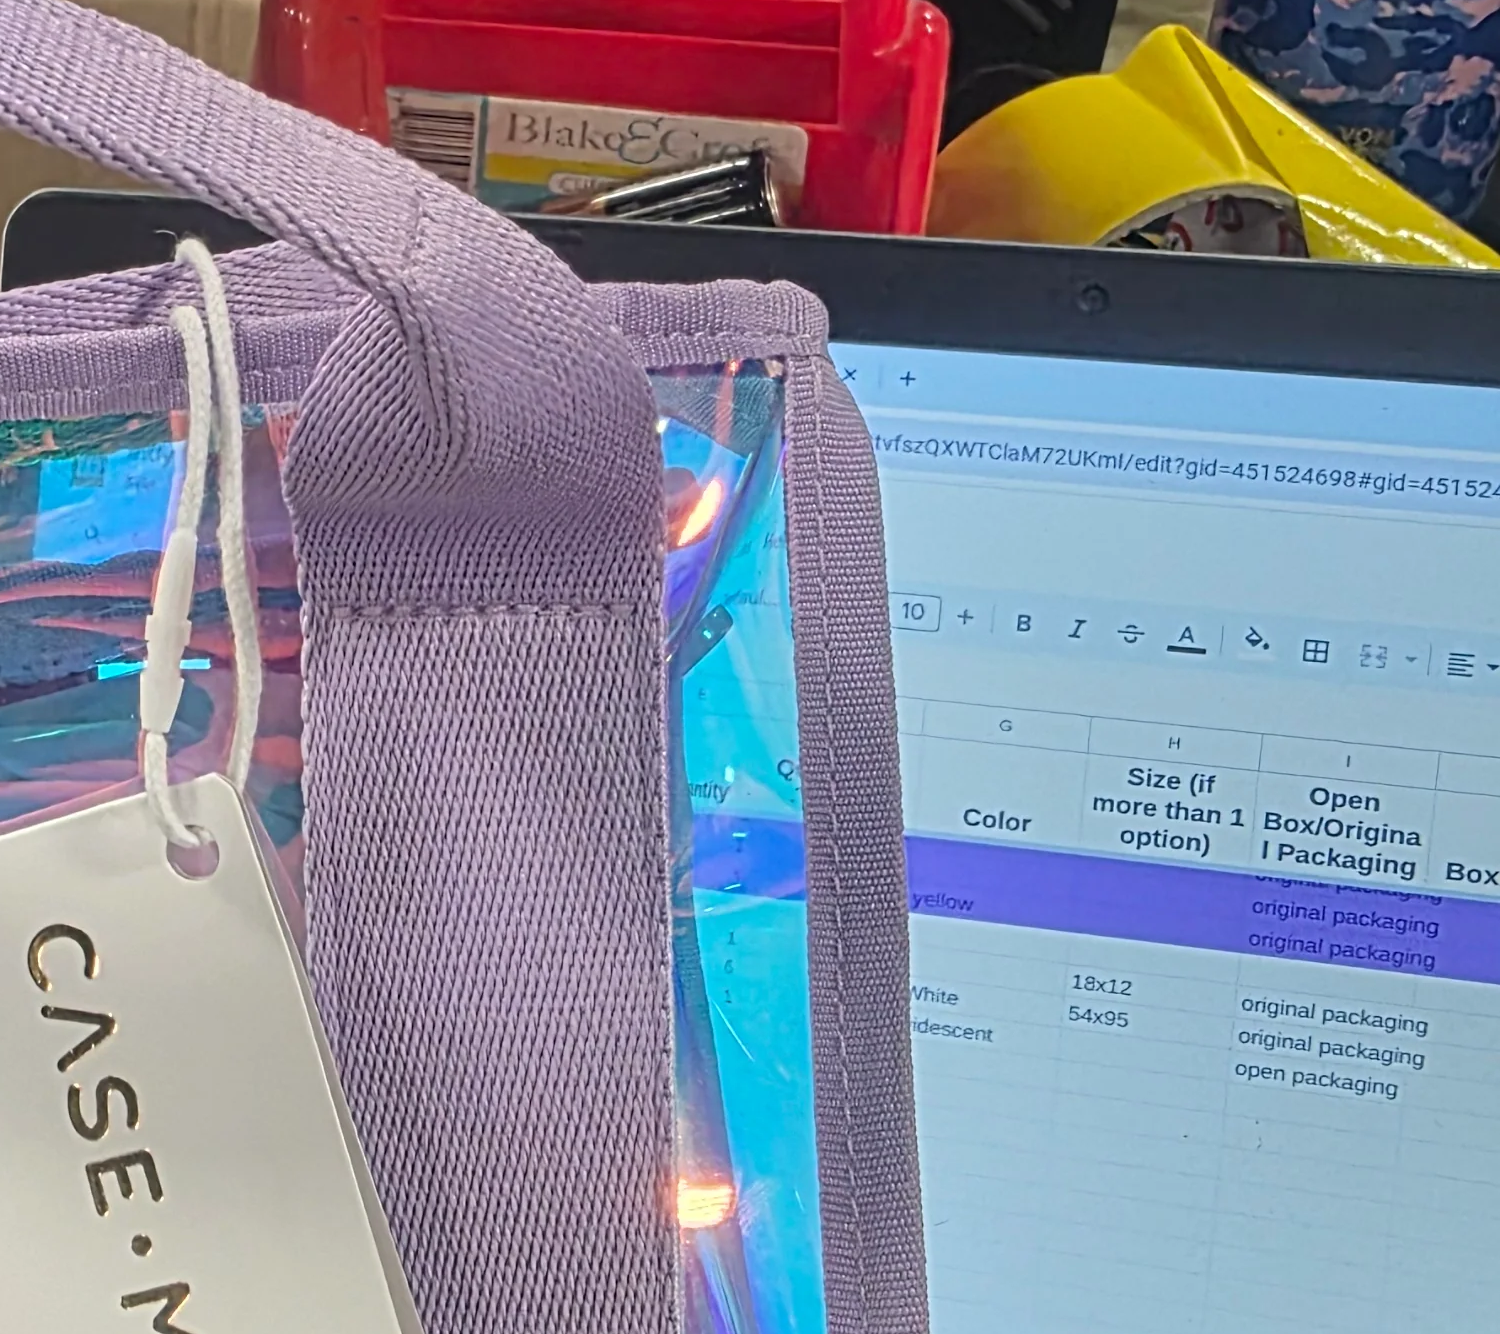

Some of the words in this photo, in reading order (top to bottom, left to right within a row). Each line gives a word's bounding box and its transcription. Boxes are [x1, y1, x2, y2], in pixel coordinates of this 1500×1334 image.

[901, 602, 925, 621] 10
[999, 719, 1013, 732] G
[1167, 736, 1181, 751] H
[1126, 767, 1181, 790] Size
[1189, 772, 1217, 797] (if
[1092, 795, 1157, 817] more
[1164, 800, 1222, 825] than
[1229, 807, 1245, 827] 1
[1309, 786, 1381, 812] Open
[962, 807, 1033, 833] Color
[1262, 811, 1423, 847] Box/Origina
[1119, 826, 1211, 857] option)
[1276, 842, 1417, 881] Packaging
[1445, 861, 1500, 886] Box
[912, 891, 975, 913] yellow
[1251, 898, 1326, 923] original
[1332, 908, 1441, 940] packaging
[1248, 931, 1323, 955] original
[1329, 941, 1437, 972] packaging
[1071, 973, 1133, 997] 18x12
[1067, 1005, 1129, 1028] 54x95
[1241, 996, 1316, 1020] original
[1322, 1007, 1430, 1038] packaging
[1237, 1028, 1312, 1053] original
[1318, 1039, 1426, 1070] packaging
[1234, 1062, 1286, 1083] open
[1292, 1069, 1399, 1101] packaging
